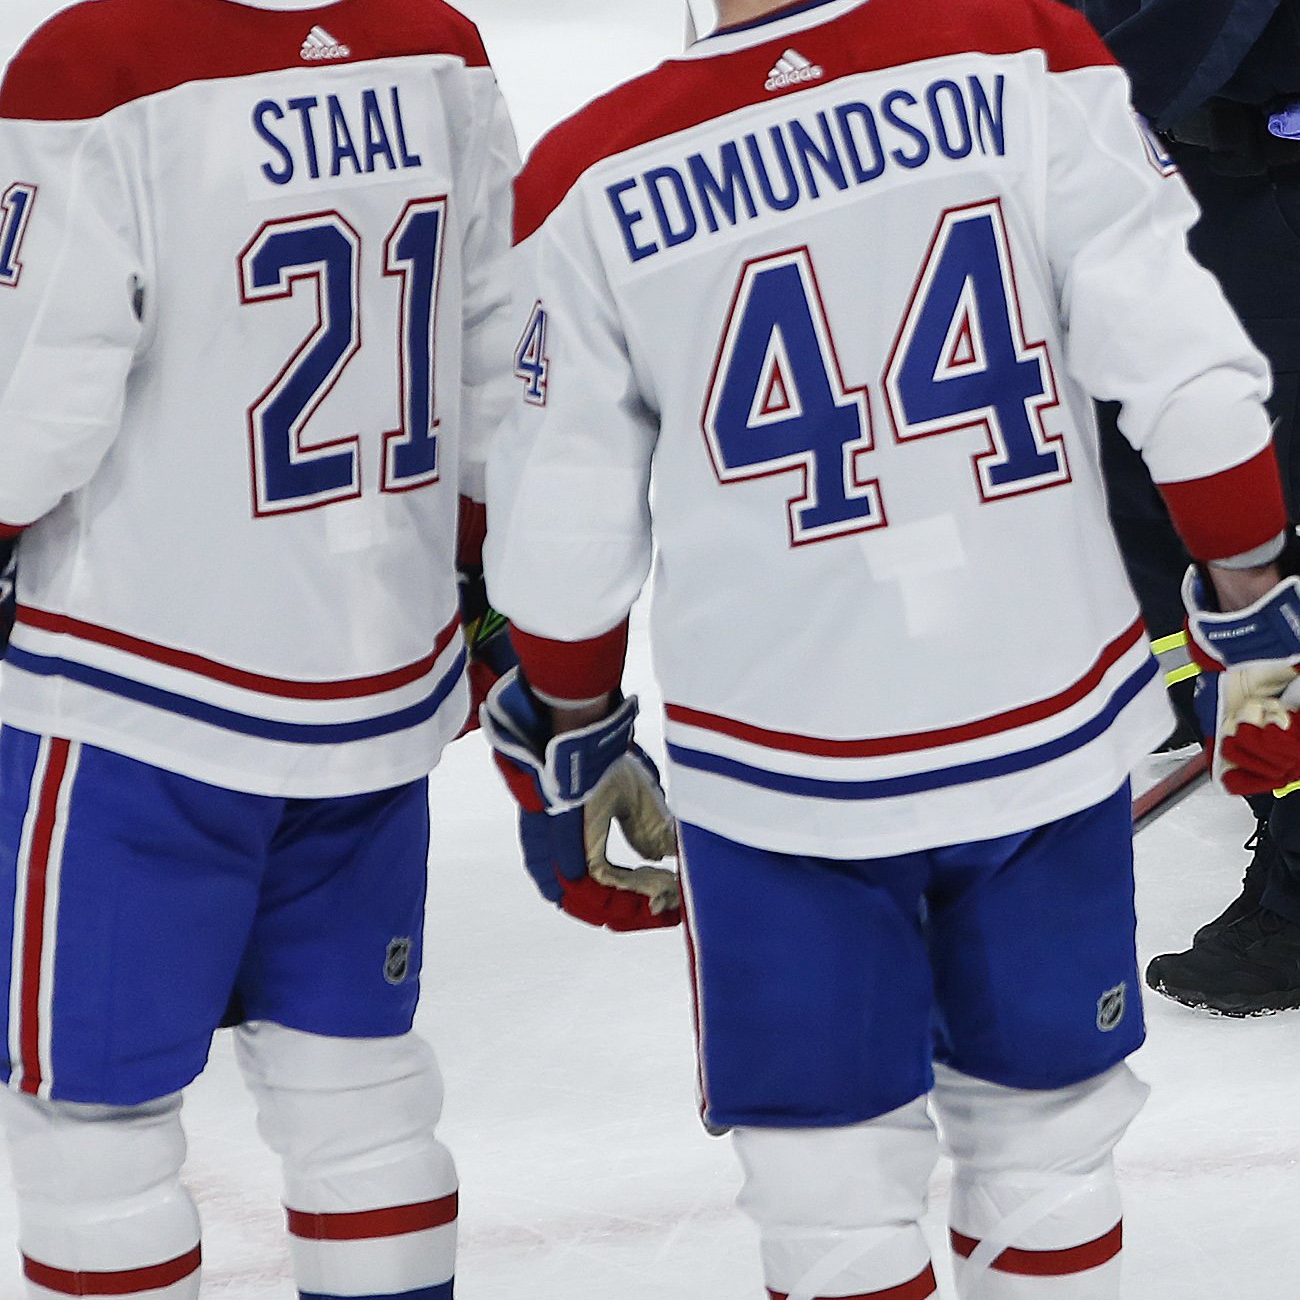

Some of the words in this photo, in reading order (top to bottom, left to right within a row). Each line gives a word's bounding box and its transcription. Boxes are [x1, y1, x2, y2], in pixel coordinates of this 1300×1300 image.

[251, 86, 422, 185] STAAL
[605, 72, 1006, 264] EDMUNDSON
[0, 181, 37, 288] 1
[238, 194, 448, 519] 21
[512, 299, 549, 406] 4
[701, 197, 1072, 548] 44
